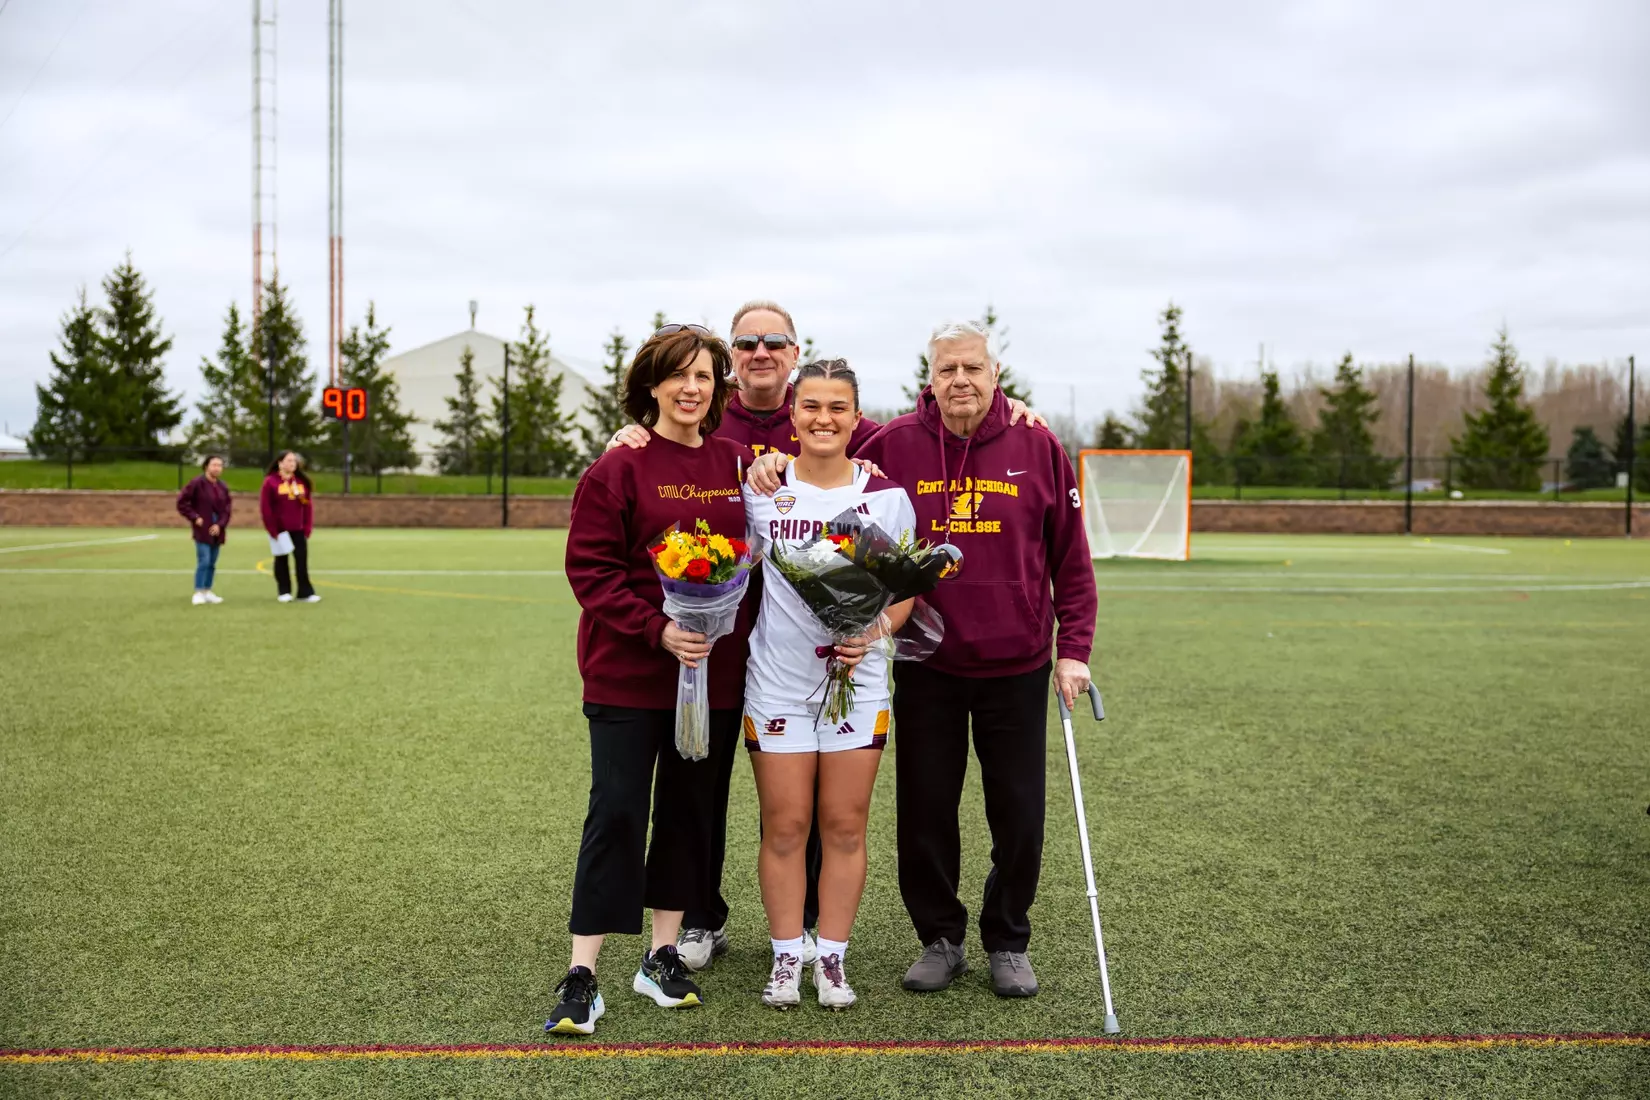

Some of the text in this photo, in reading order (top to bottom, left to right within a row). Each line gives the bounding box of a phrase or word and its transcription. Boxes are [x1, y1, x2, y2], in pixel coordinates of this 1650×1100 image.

[324, 388, 365, 420] 90
[657, 485, 679, 499] CMU
[679, 484, 740, 504] Chippewas
[1068, 487, 1082, 509] 3
